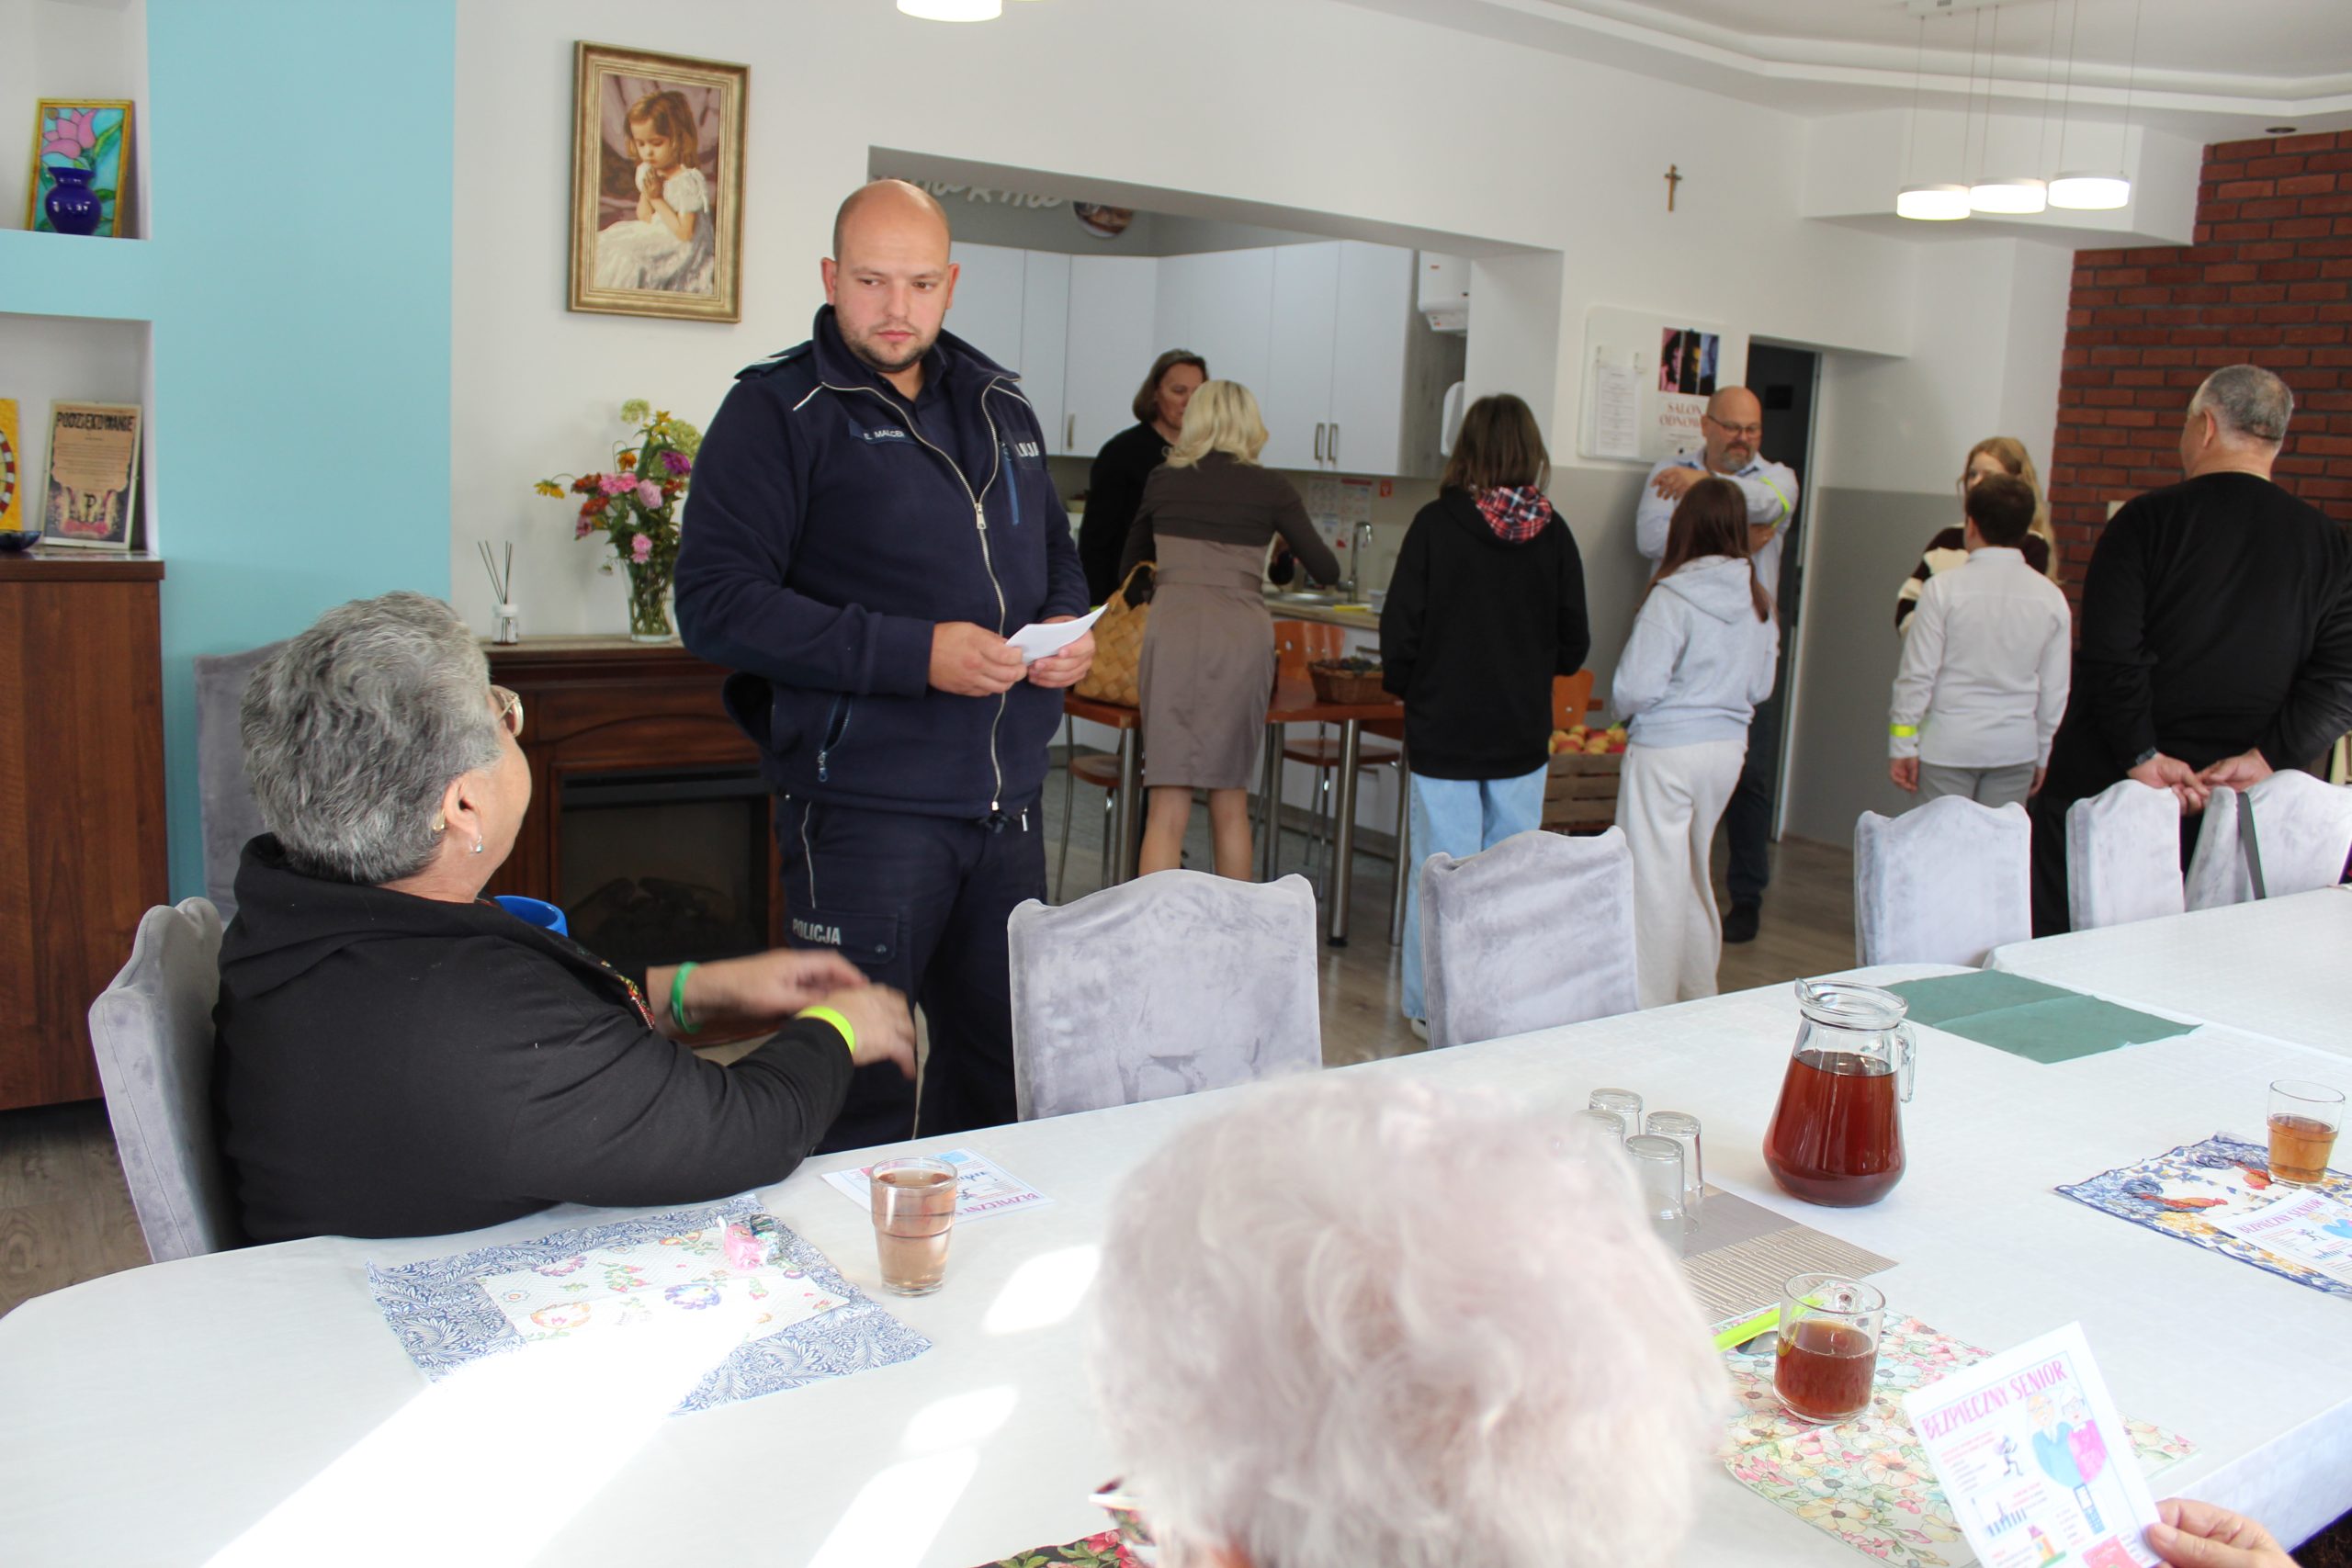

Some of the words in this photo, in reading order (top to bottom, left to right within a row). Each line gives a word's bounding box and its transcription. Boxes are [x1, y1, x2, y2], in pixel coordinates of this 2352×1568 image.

[793, 919, 842, 945] POLICJA
[1921, 1386, 2009, 1440] BEZPIECZNY
[2009, 1359, 2068, 1401] SENIOR
